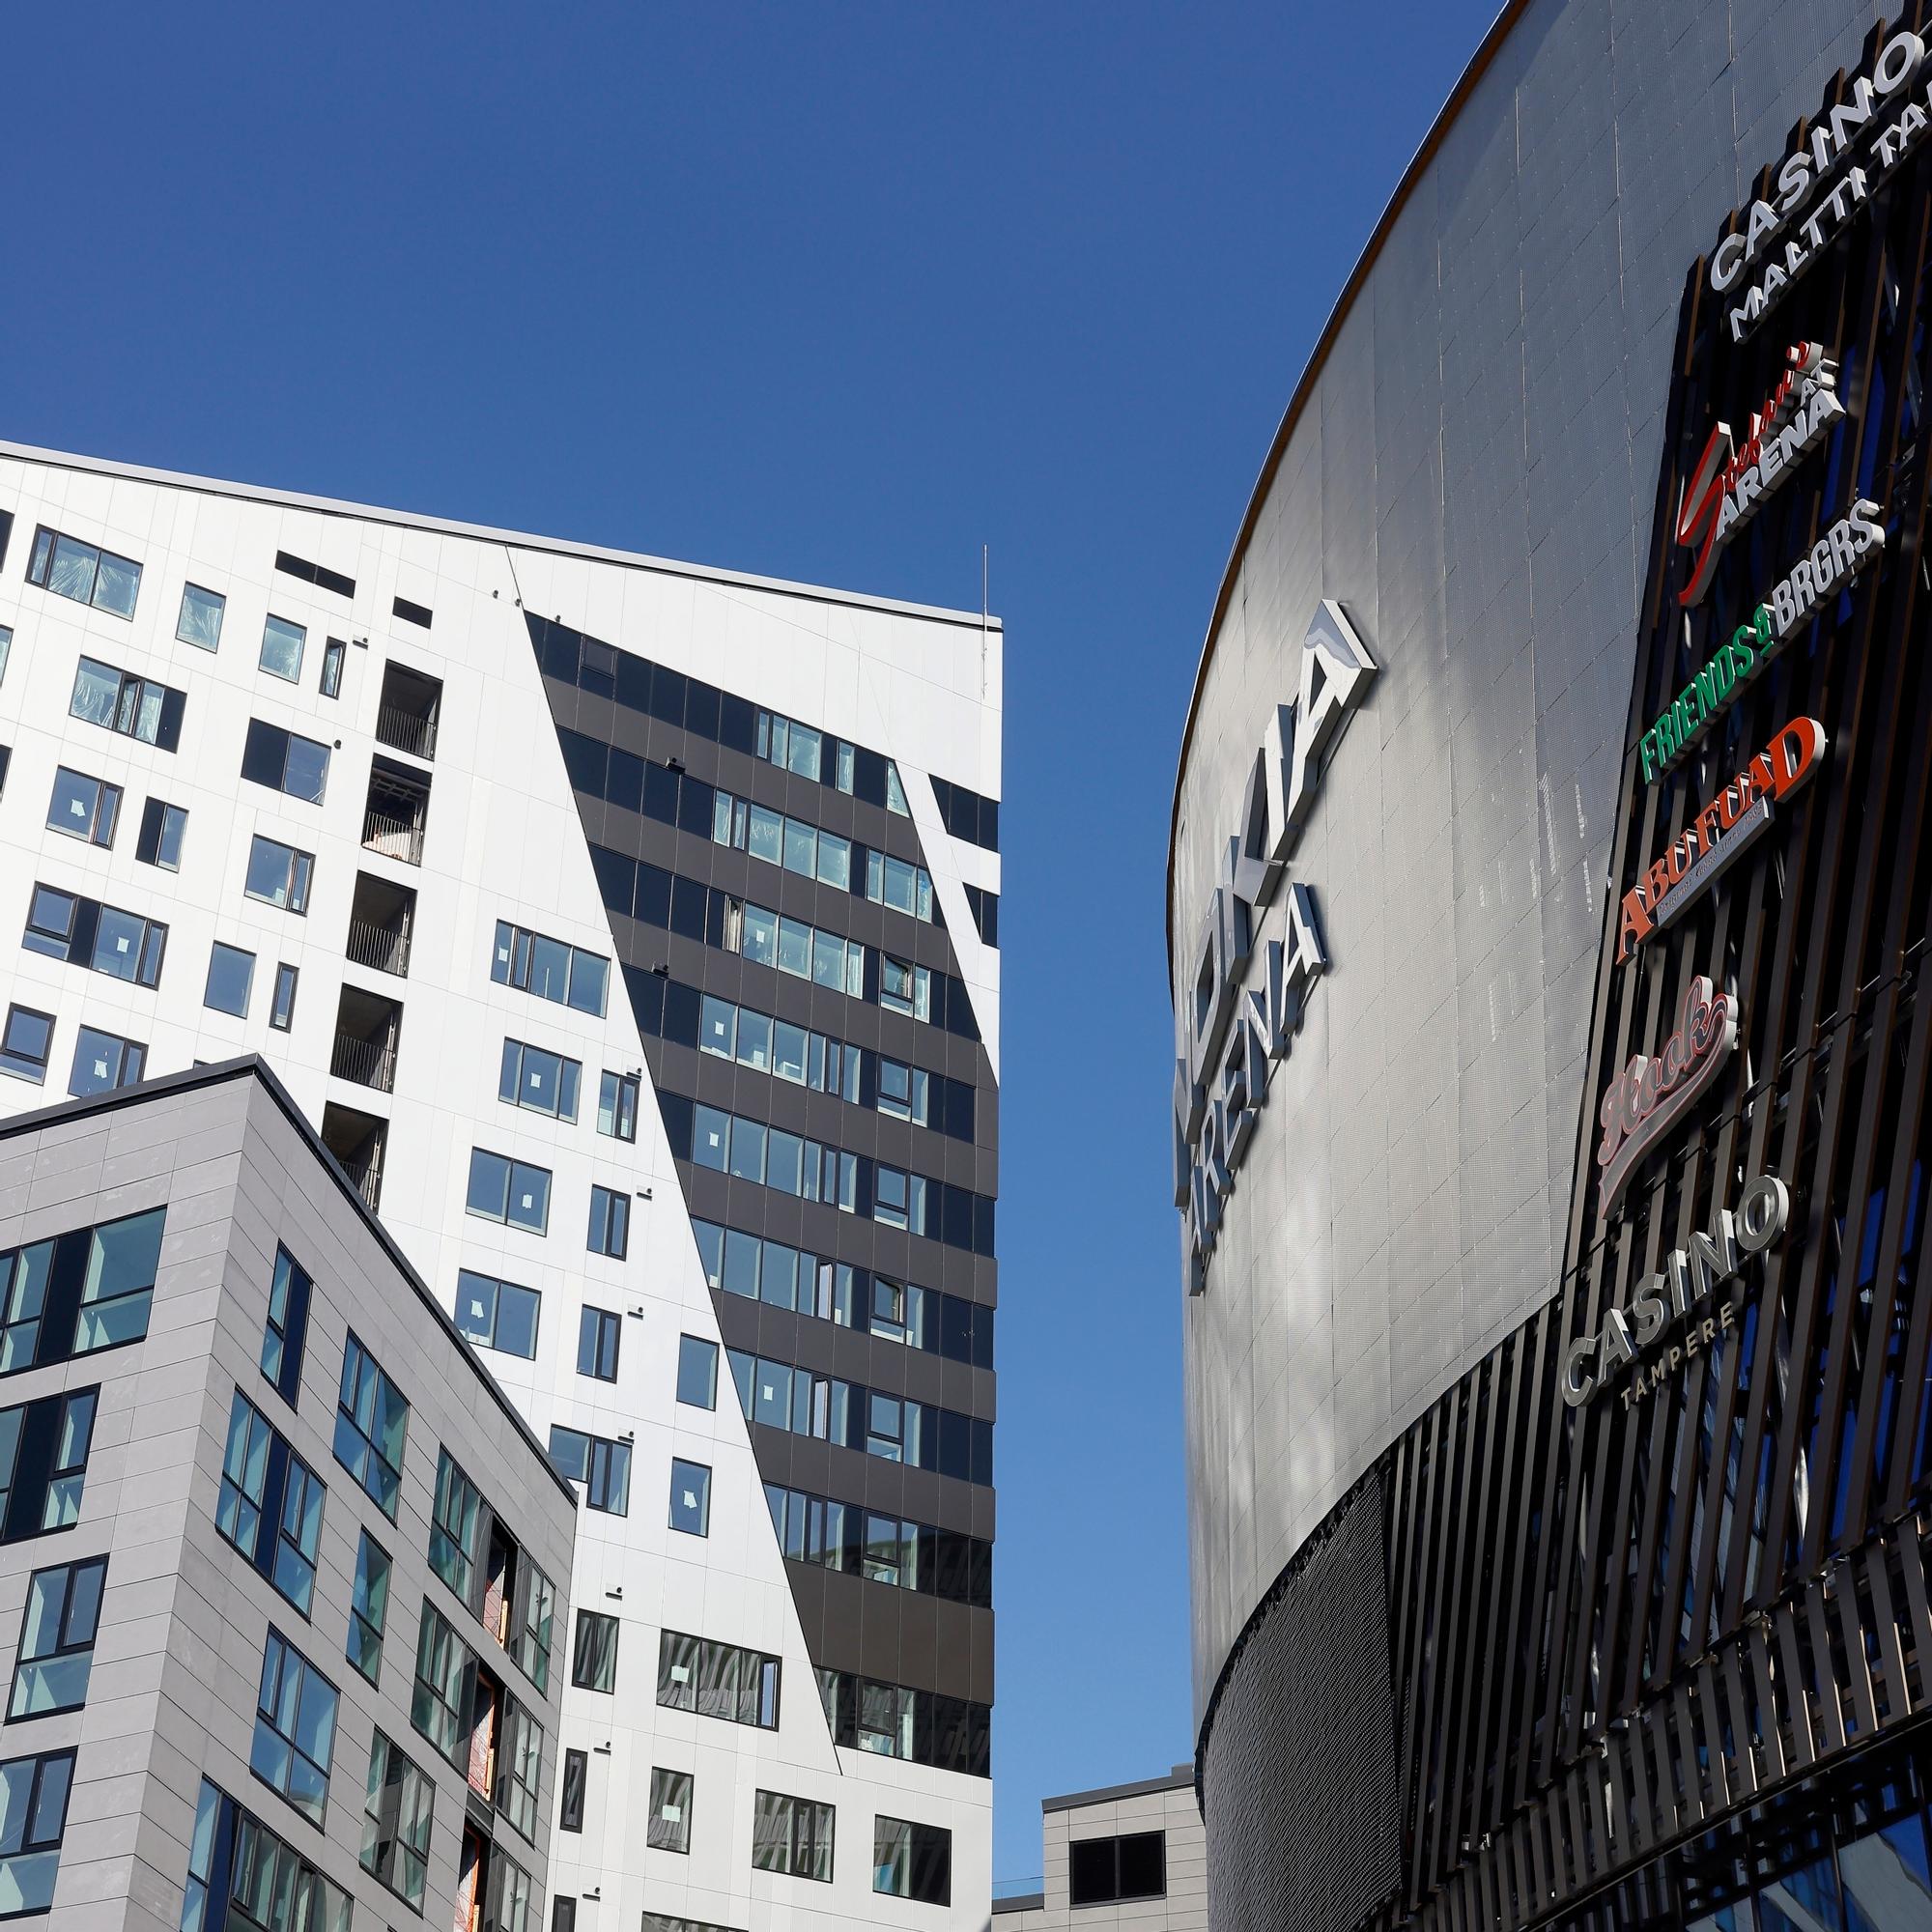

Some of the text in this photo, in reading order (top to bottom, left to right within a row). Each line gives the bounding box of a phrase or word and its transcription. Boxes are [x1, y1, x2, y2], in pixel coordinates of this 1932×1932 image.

[1710, 31, 1924, 291] CASINO
[1729, 80, 1932, 342] MALTTI TA
[1717, 388, 1845, 541] ARENA
[1801, 357, 1839, 407] AT
[1640, 625, 1756, 784] FRIENDS
[1772, 498, 1885, 638] BRGRS
[1174, 599, 1378, 1208] NOKIA
[1188, 882, 1326, 1296] ARENA
[1561, 1175, 1789, 1406] CASINO
[1621, 1301, 1735, 1411] TAMPERE
